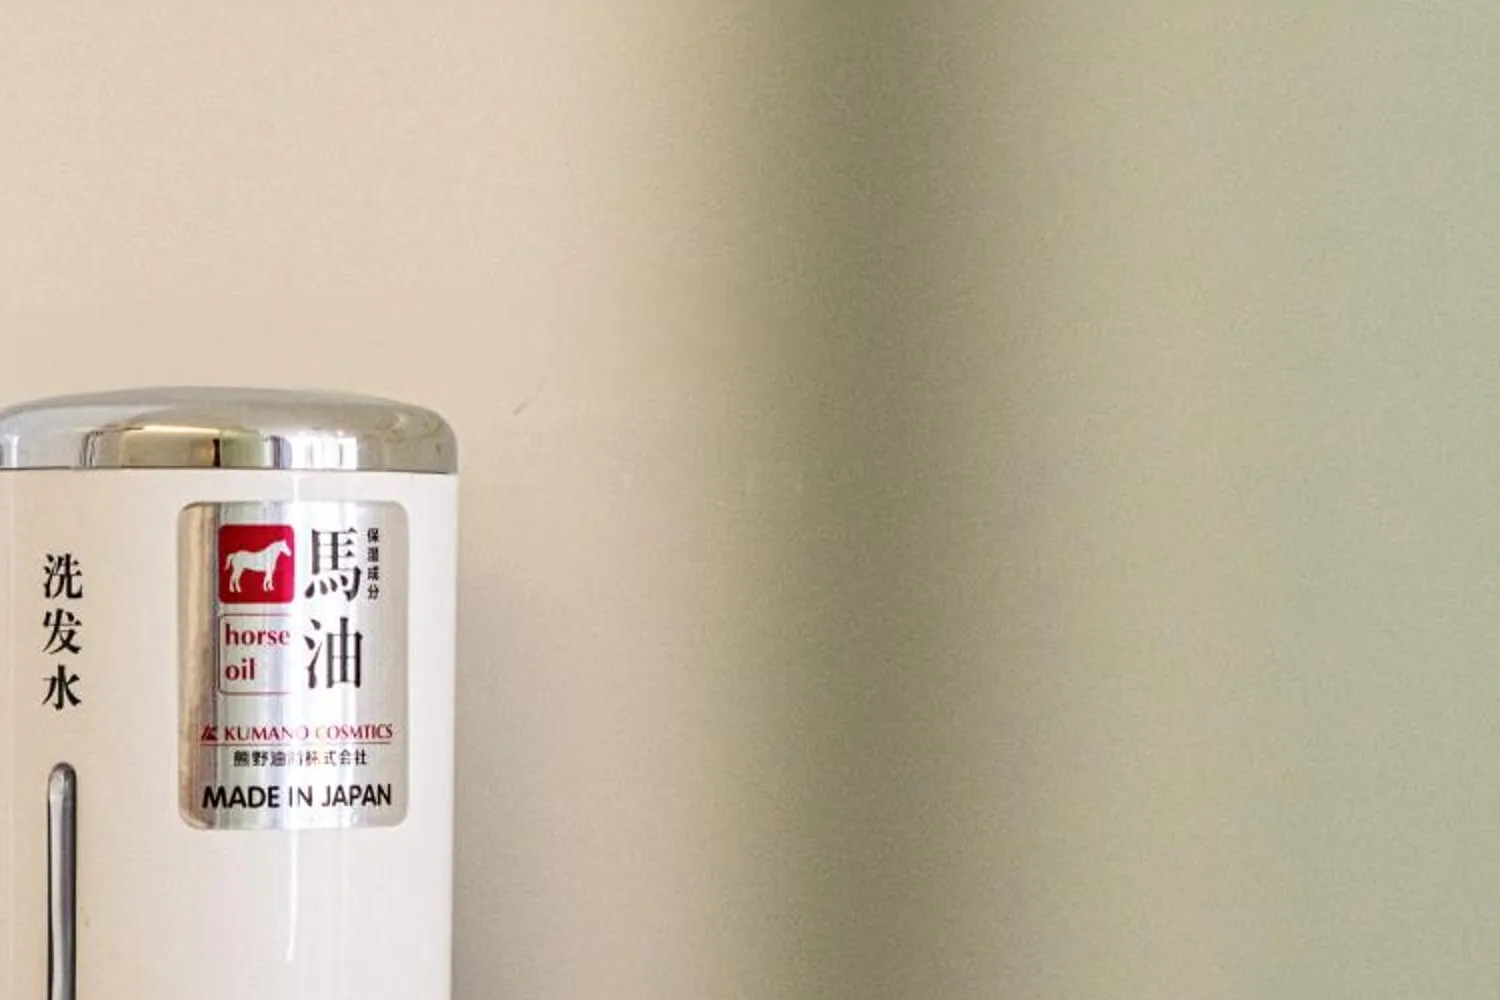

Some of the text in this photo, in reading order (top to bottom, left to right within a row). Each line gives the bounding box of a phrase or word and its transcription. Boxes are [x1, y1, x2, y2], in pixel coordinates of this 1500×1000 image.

[303, 527, 364, 690] 馬油
[41, 553, 84, 711] 洗发水
[224, 623, 290, 646] horse
[224, 657, 256, 680] oil
[224, 725, 309, 741] KUMANO
[233, 748, 367, 767] 熊野油株式会社
[202, 783, 392, 809] MADE IN JAPAN
